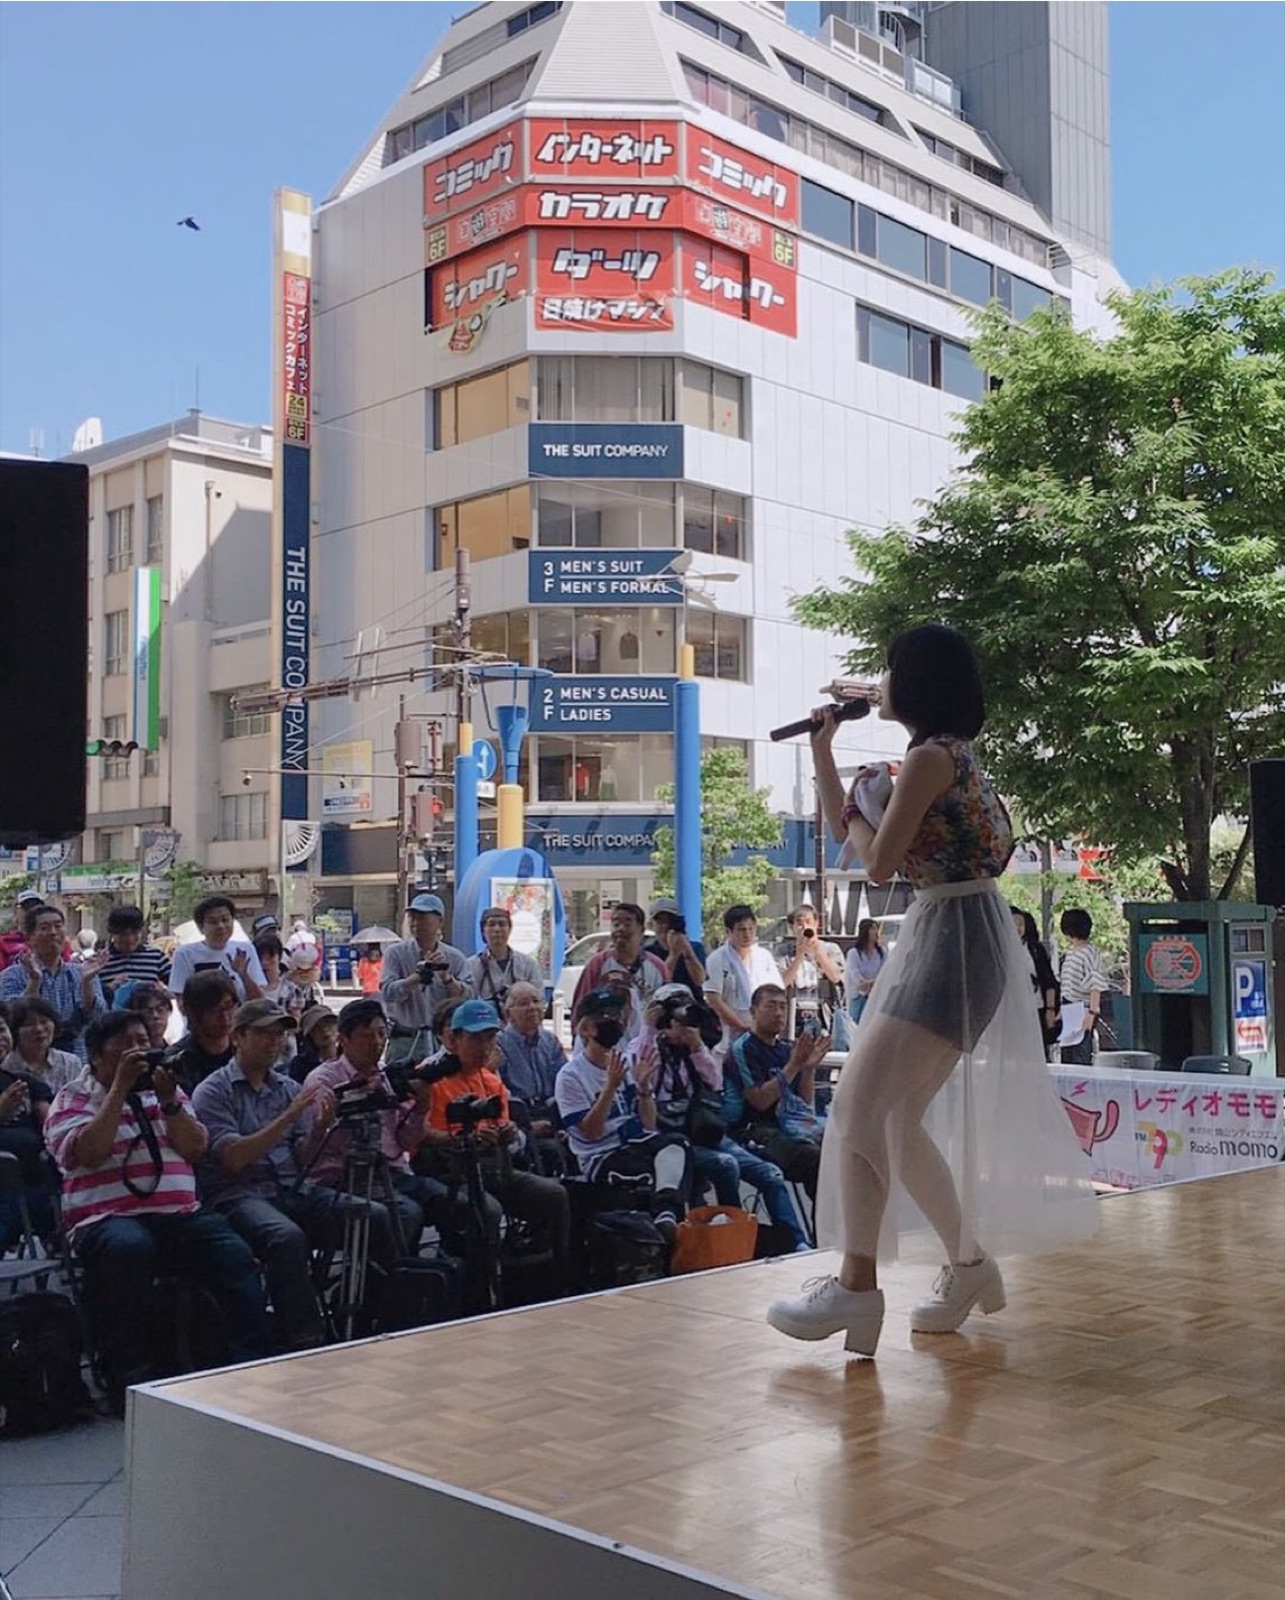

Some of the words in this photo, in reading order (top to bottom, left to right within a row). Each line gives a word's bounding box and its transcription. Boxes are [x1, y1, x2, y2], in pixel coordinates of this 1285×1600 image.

[536, 132, 674, 165] インターネット
[433, 139, 515, 204] コミック
[698, 145, 788, 208] コミック
[538, 191, 669, 220] カラオケ
[551, 248, 663, 281] ダーツ
[774, 243, 794, 266] 6F
[443, 259, 518, 310] シャワー
[693, 259, 786, 309] シャワー
[543, 444, 569, 457] THE
[572, 444, 602, 457] SUIT
[604, 444, 669, 458] COMPANY
[286, 546, 306, 593] THE
[560, 561, 607, 573] MEN'S
[610, 561, 644, 573] SUIT
[560, 582, 607, 594] MEN'S
[610, 582, 670, 594] FORMAL
[286, 598, 306, 652] SUIT
[560, 687, 607, 700] MEN'S
[610, 687, 667, 700] CASUAL
[285, 655, 306, 771] COPANY
[560, 708, 612, 721] LADIES
[543, 834, 569, 848] THE
[572, 834, 603, 847] SUIT
[1235, 967, 1255, 1013] P
[1134, 1087, 1278, 1120] レディオモモ
[1220, 1140, 1279, 1159] momo
